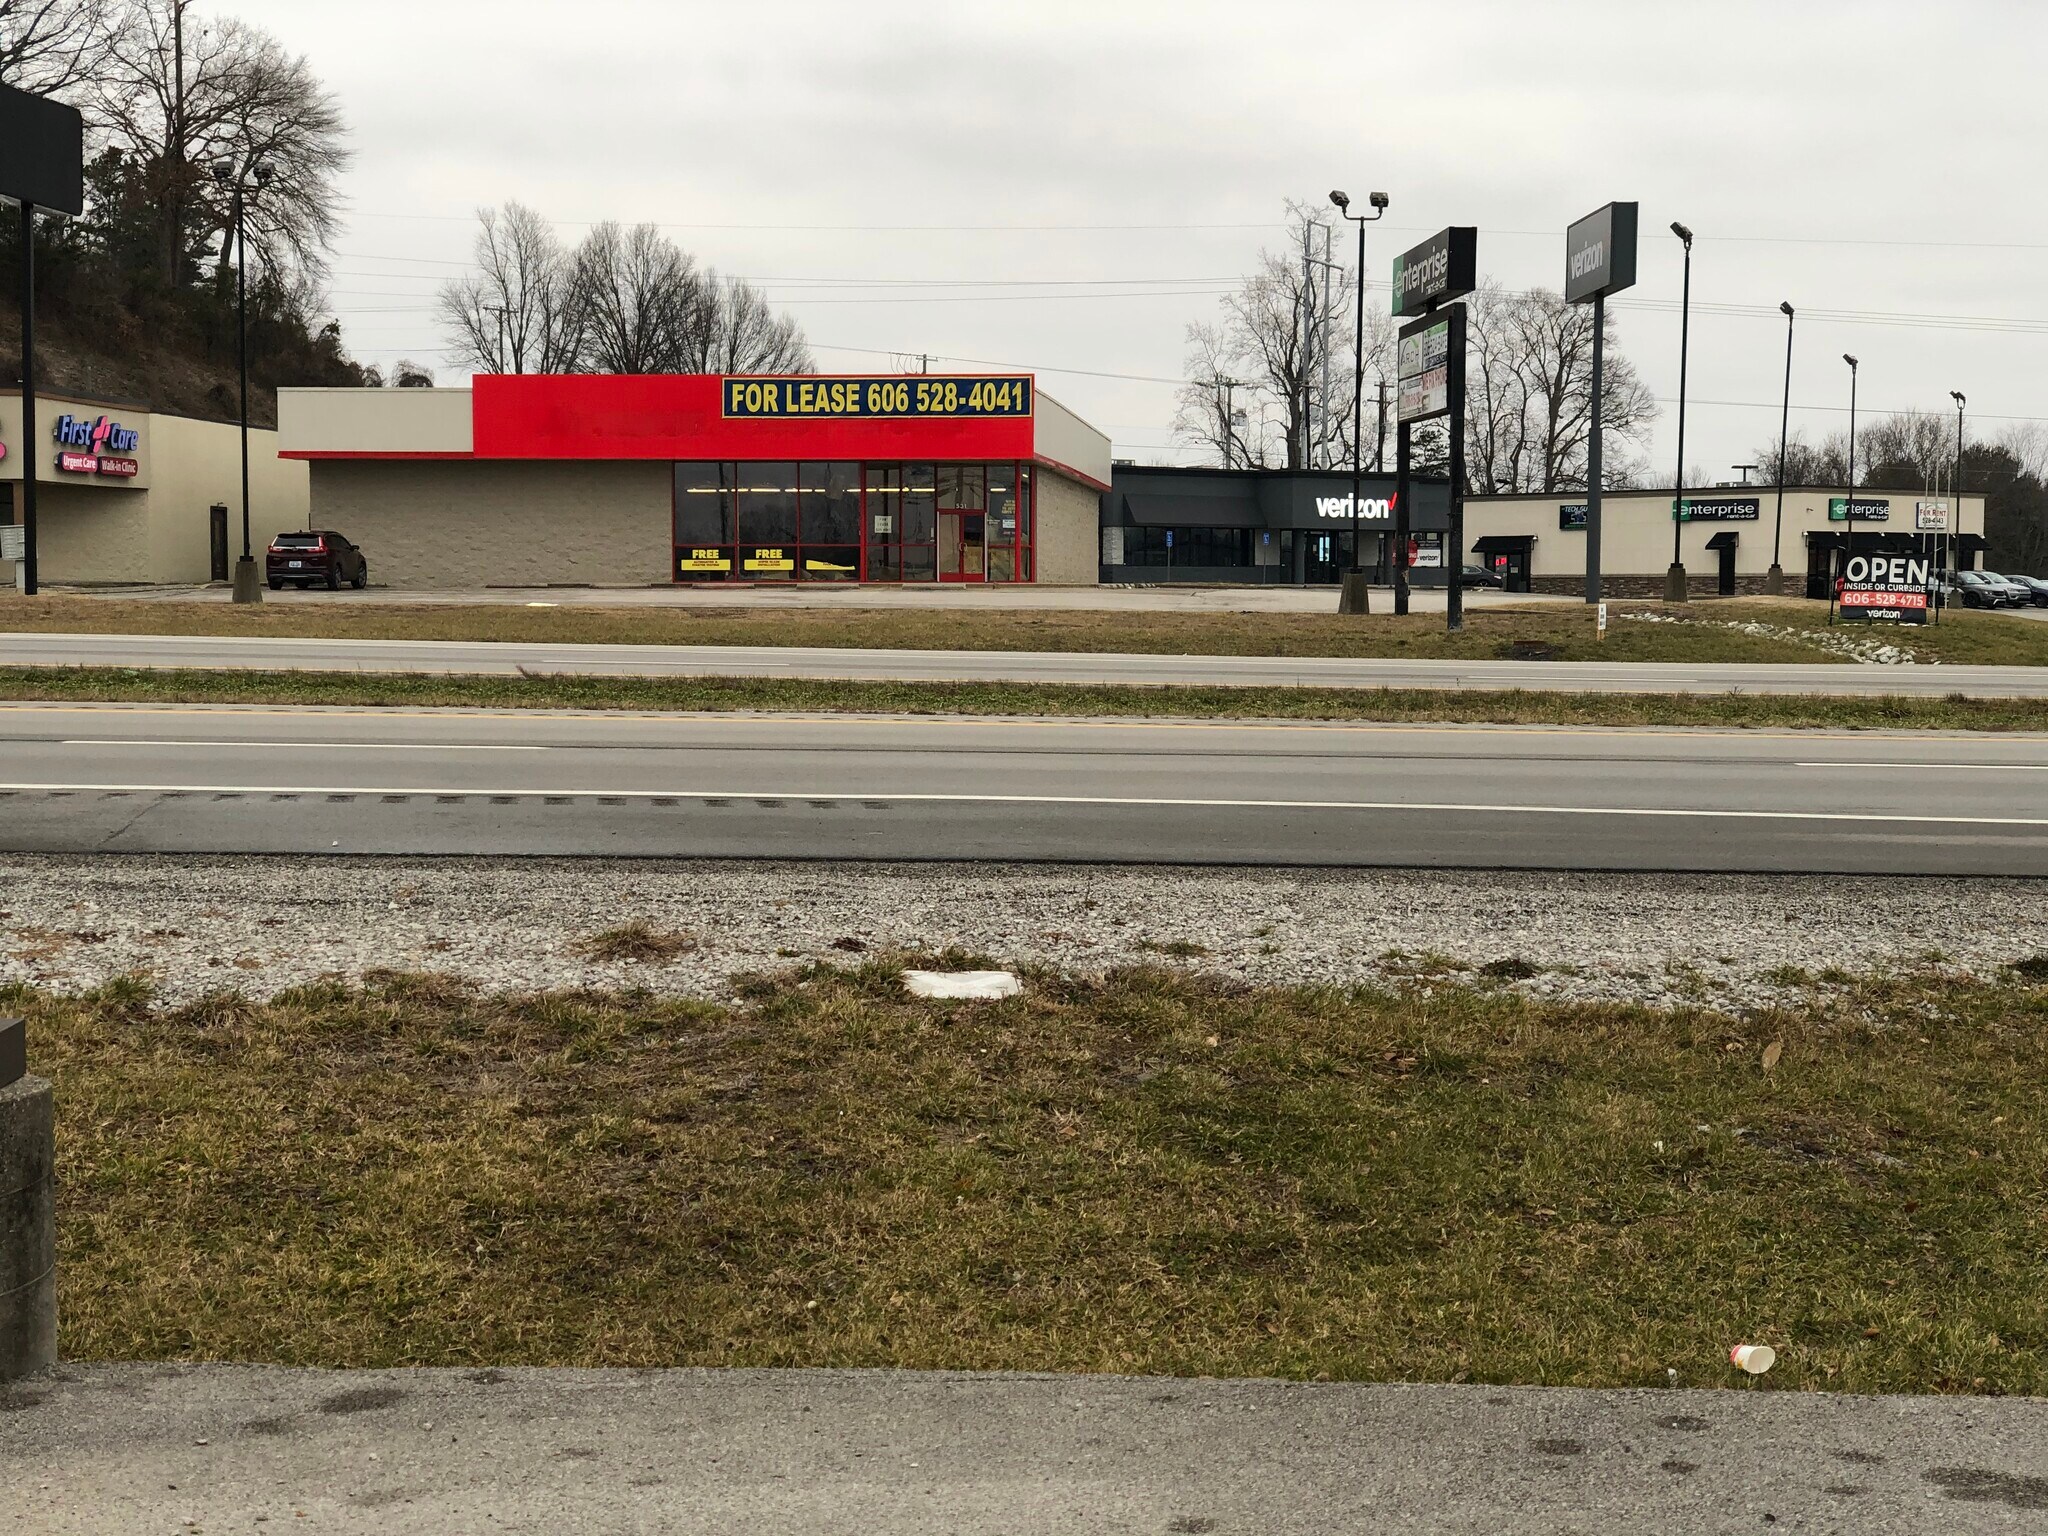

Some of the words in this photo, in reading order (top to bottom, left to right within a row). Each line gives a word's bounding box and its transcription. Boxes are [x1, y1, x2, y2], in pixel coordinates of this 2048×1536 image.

[1571, 240, 1603, 280] verizon
[1393, 245, 1448, 298] enterprise
[731, 384, 779, 412] FOR
[786, 384, 860, 412] LEASE
[867, 383, 909, 412] 606
[916, 382, 1023, 412] 528-4041
[59, 415, 92, 446] First
[108, 423, 139, 451] Care
[63, 455, 83, 469] Urgent
[83, 457, 96, 469] Care
[101, 459, 122, 472] Walk-in
[122, 461, 136, 473] Clinic
[1315, 492, 1390, 519] verizon
[1673, 502, 1755, 517] enterprise
[692, 549, 719, 559] FREE
[755, 549, 783, 559] FREE
[1847, 556, 1929, 584] OPEN
[1844, 582, 1873, 591] INSIDE
[1874, 583, 1886, 591] OR
[1887, 583, 1926, 593] CURBSIDE
[1844, 593, 1924, 607] 606-528-4715
[1866, 608, 1901, 619] verizon
